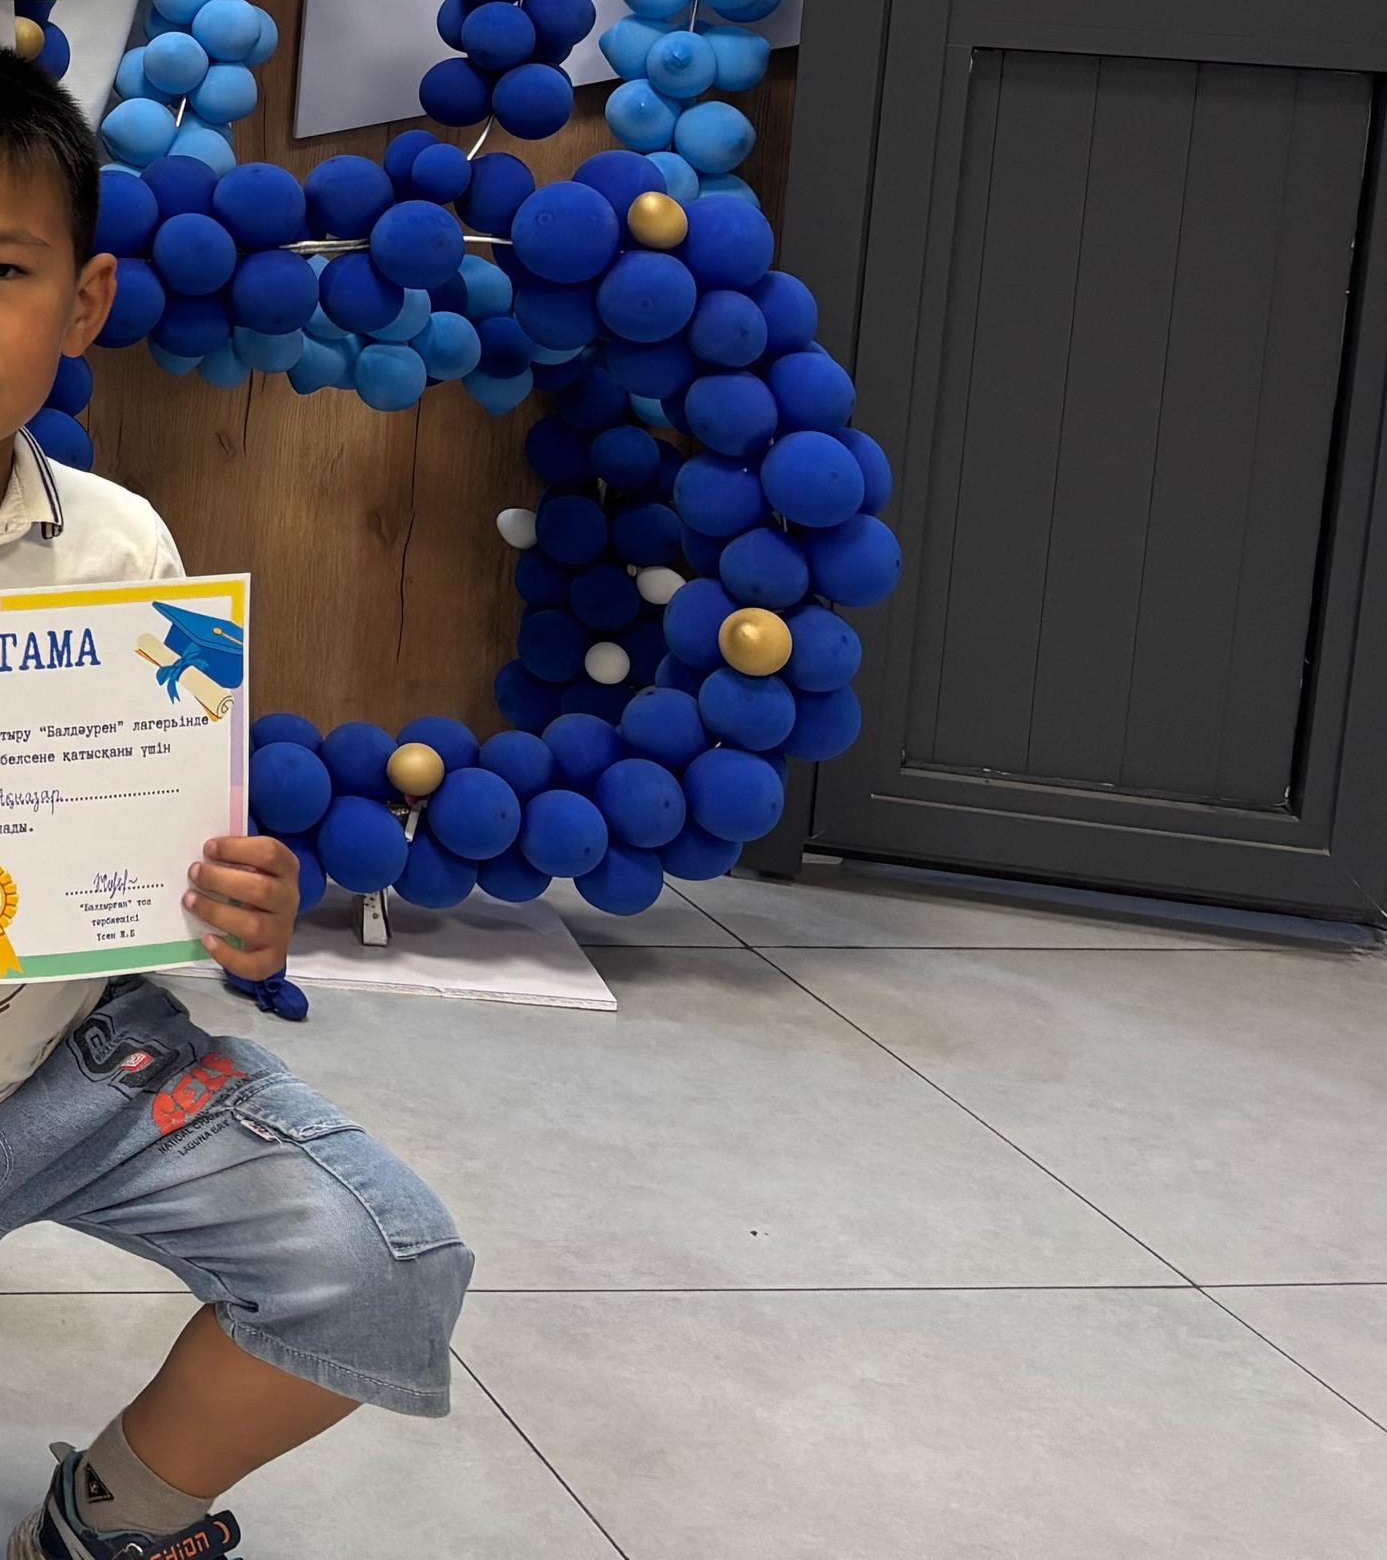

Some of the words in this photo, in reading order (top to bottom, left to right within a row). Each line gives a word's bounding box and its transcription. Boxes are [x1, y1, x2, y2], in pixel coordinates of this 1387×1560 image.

[132, 715, 210, 732] лагерьінде
[0, 752, 56, 766] белсене
[62, 746, 133, 763] қатысқаны
[140, 741, 171, 758] үшін
